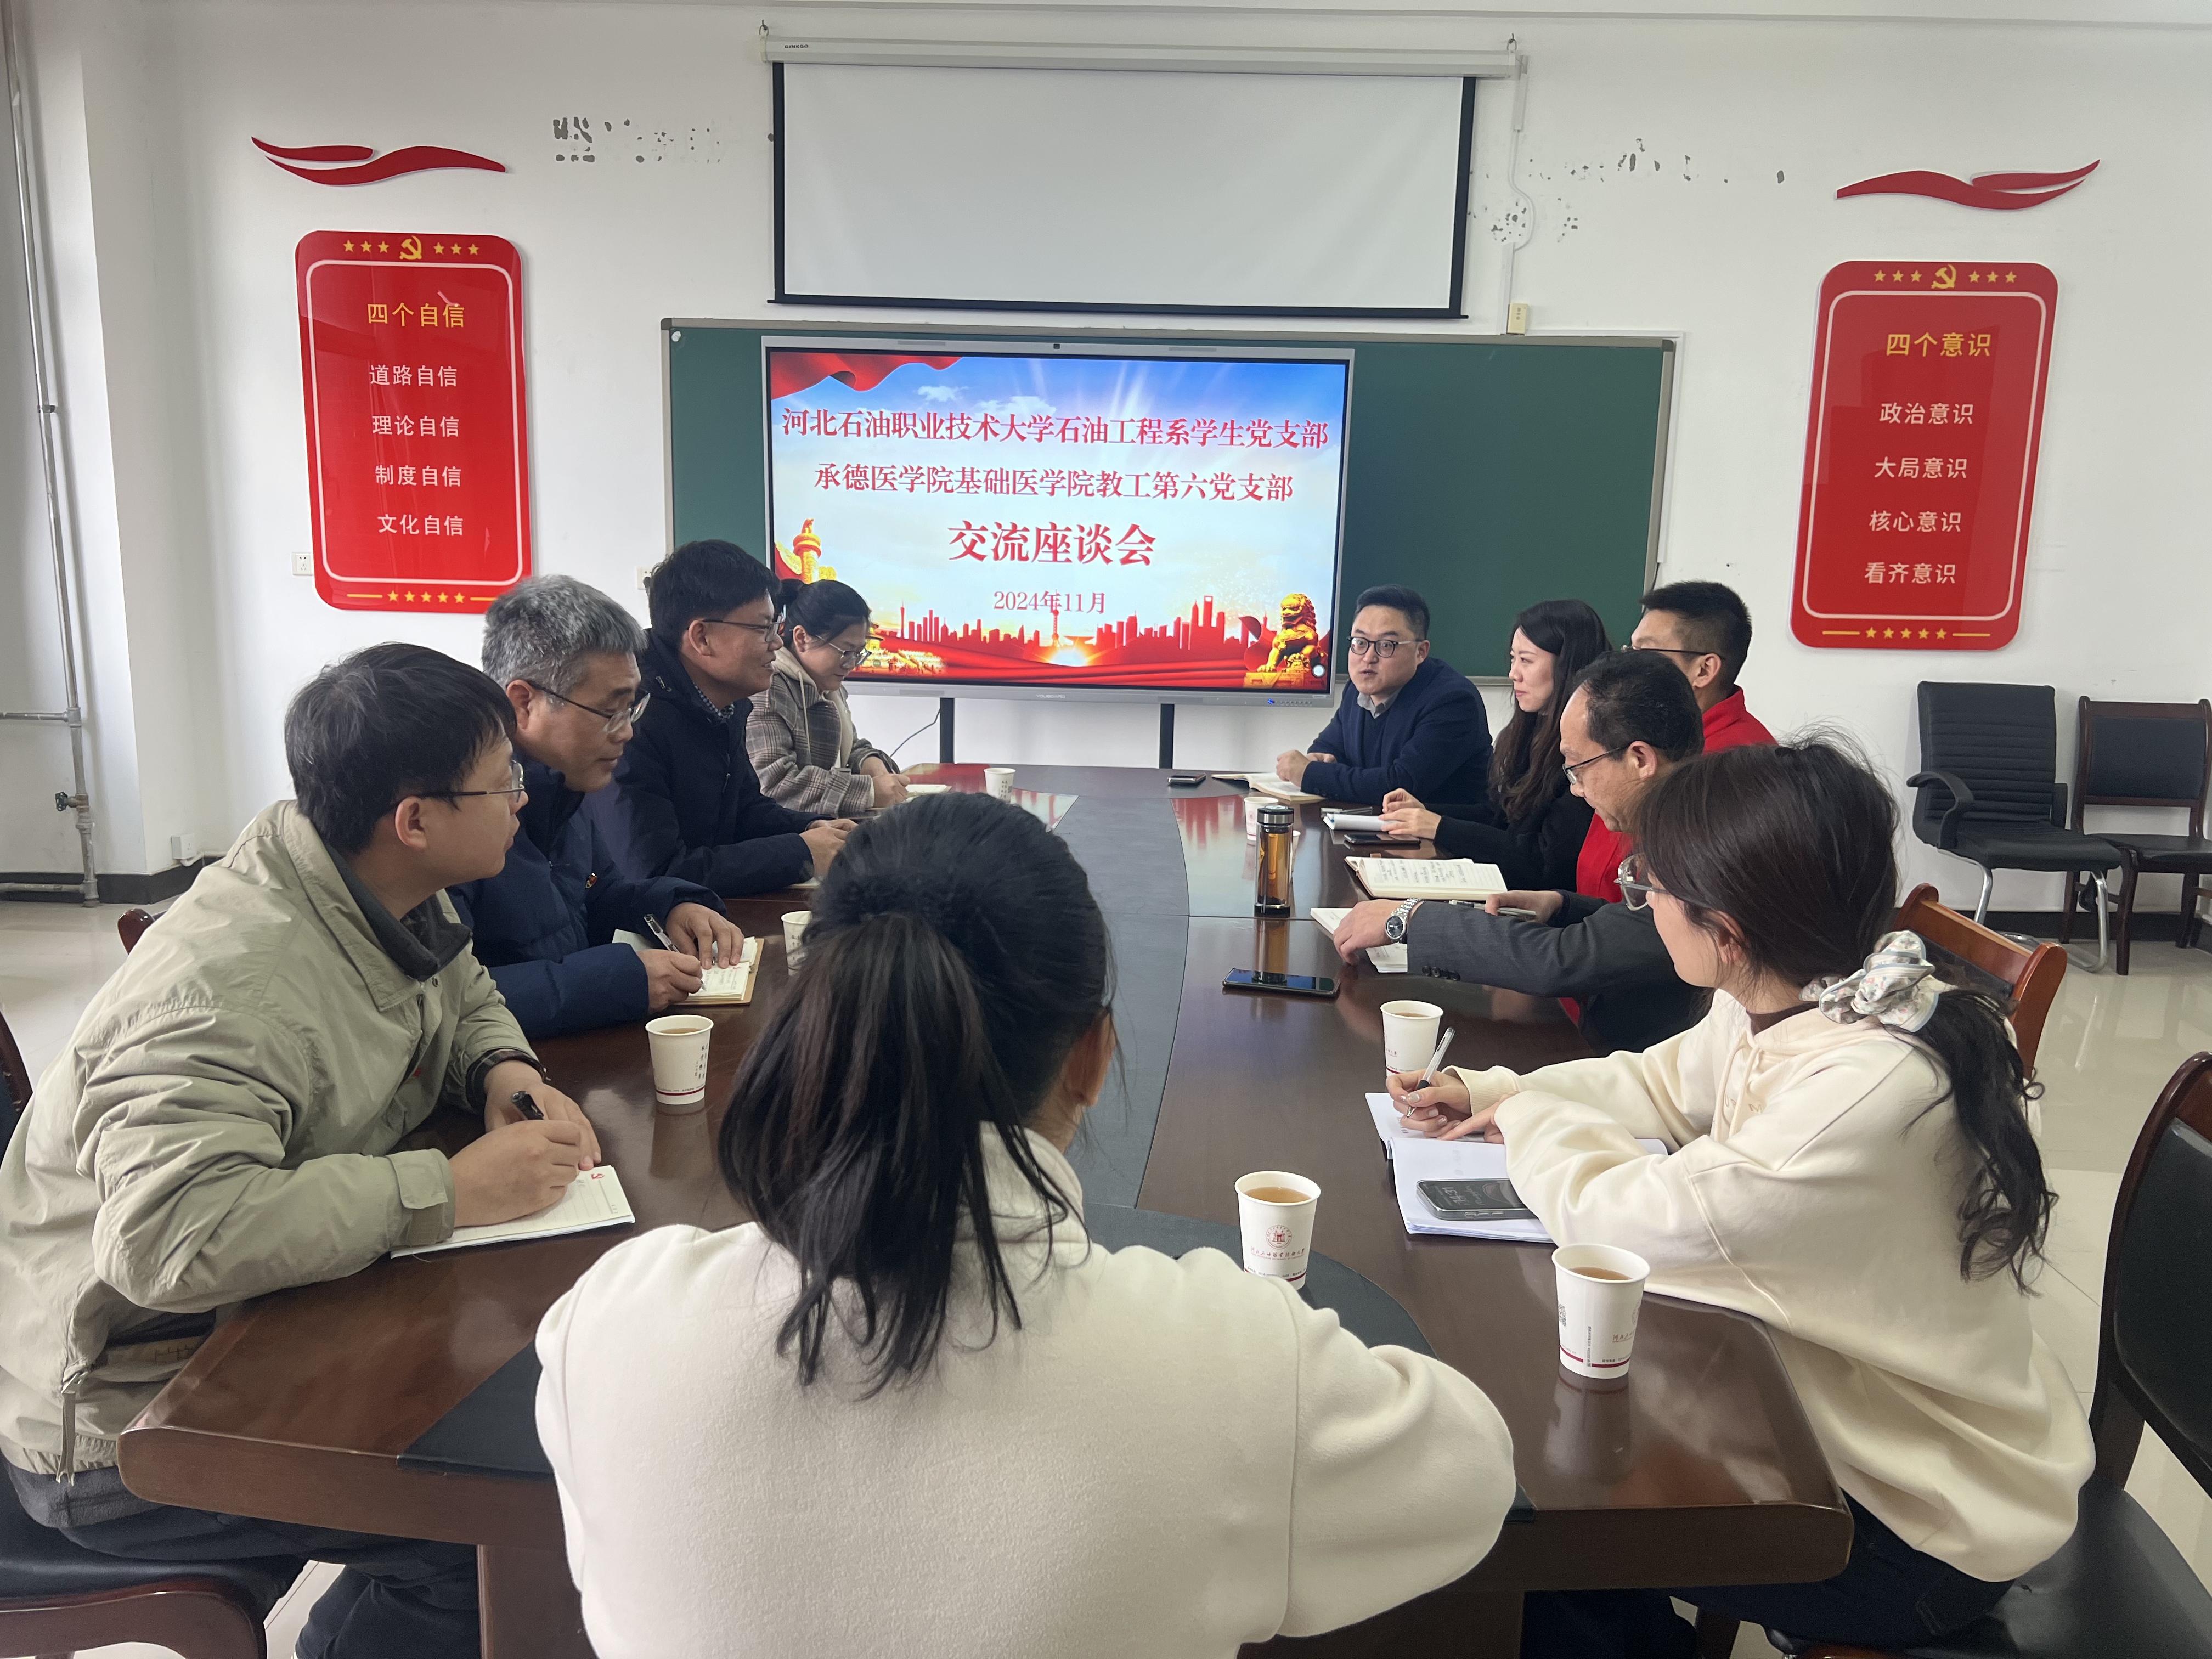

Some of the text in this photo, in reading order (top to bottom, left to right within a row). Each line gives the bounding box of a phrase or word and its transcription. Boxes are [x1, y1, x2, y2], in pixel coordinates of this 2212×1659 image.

[368, 302, 465, 327] 四个自信
[1886, 332, 1991, 357] 四个意识
[370, 365, 457, 387] 道路自信
[1879, 402, 1973, 424] 政治意识
[372, 415, 459, 437] 理论自信
[782, 408, 1329, 449] 河北石油职业技术大学石油工程系学生党支部
[375, 465, 461, 487] 制度自信
[1875, 456, 1967, 478] 大局意识
[814, 463, 1293, 501] 承德医学院基础医学院教工第六党支部
[377, 514, 464, 536] 文化自信
[1869, 510, 1961, 532] 核心意识
[947, 520, 1156, 566] 交流座谈会
[1865, 562, 1956, 584] 看齐意识
[994, 590, 1105, 614] 2024年11月
